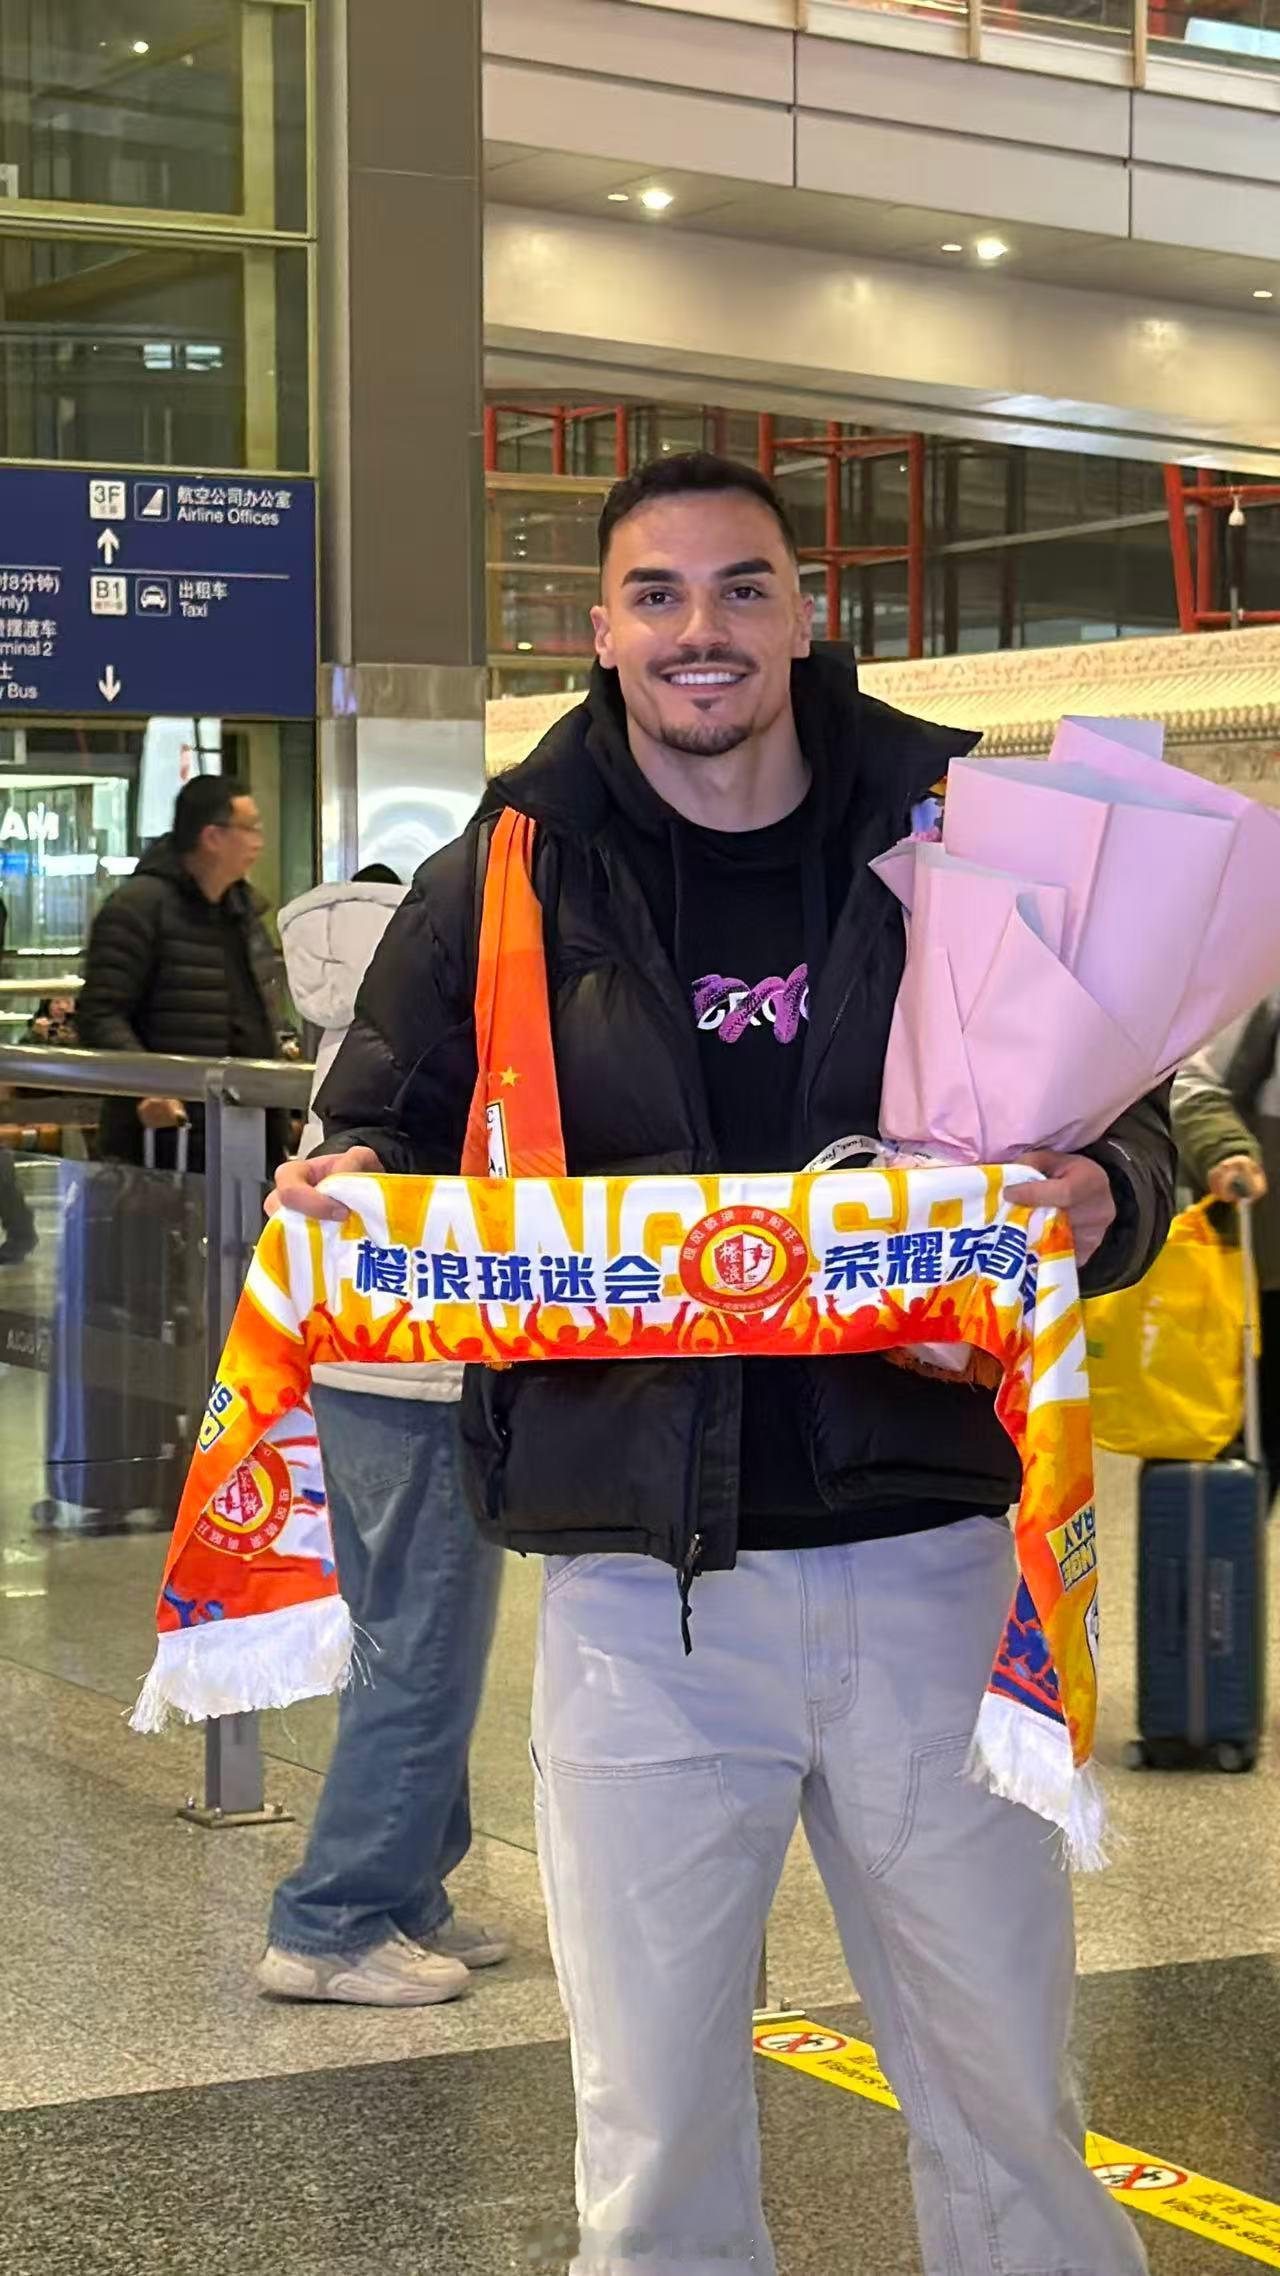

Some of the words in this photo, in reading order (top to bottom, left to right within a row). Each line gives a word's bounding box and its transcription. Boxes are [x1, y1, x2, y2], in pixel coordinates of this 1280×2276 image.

[94, 485, 121, 503] 3F
[178, 485, 292, 509] 航空公司办公室
[177, 506, 224, 523] Airline
[227, 508, 280, 526] Offices
[96, 580, 120, 599] B1
[179, 578, 228, 600] 出租车
[0, 594, 29, 614] nly)
[180, 601, 208, 617] Taxi
[42, 641, 53, 657] 2
[7, 682, 38, 699] Bus
[356, 1240, 661, 1304] 橙浪球迷会
